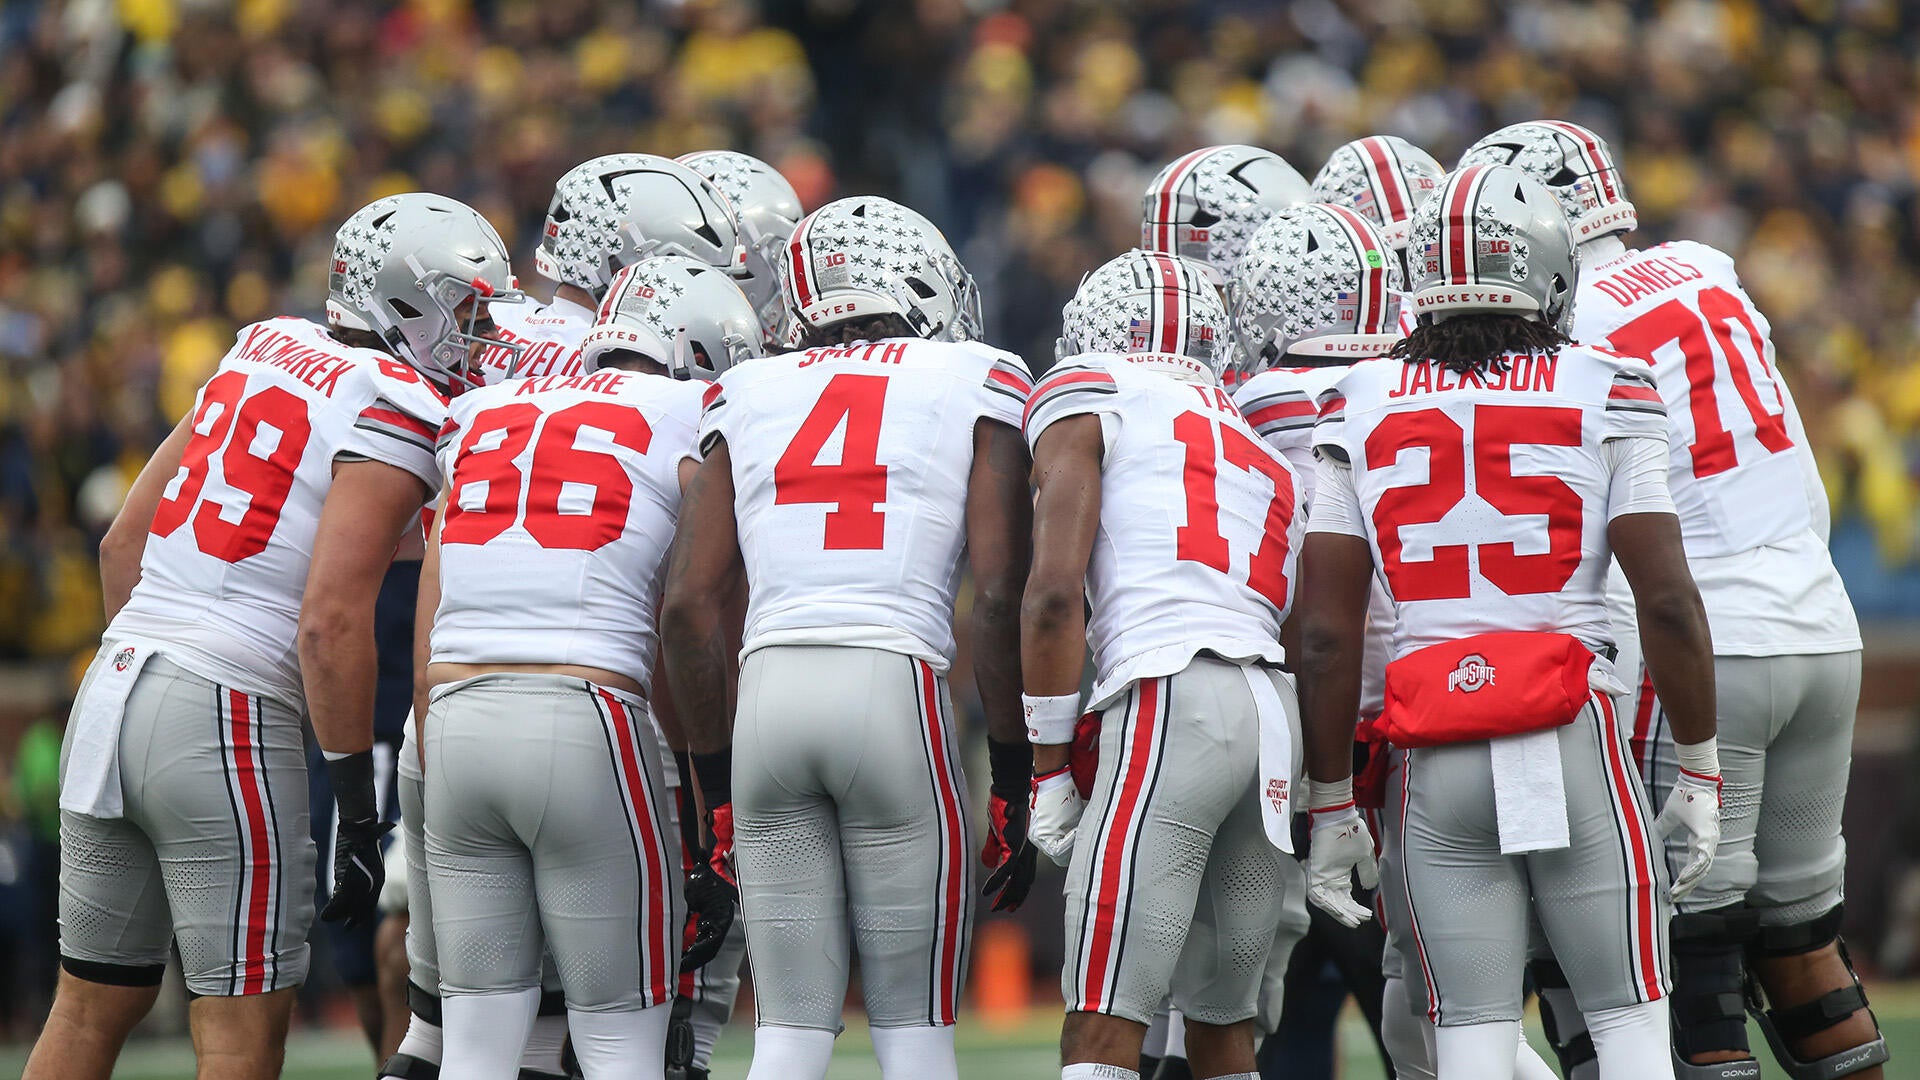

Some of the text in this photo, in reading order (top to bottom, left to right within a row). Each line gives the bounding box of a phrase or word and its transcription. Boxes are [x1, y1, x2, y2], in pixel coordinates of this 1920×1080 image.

[1426, 260, 1438, 272] 25
[1592, 256, 1704, 308] DANIELS
[1341, 310, 1354, 321] 10
[1417, 293, 1512, 307] BUCKEYES
[580, 331, 638, 353] CKEYES
[789, 303, 856, 344] BUCEYES
[1132, 336, 1145, 348] 17
[235, 324, 356, 399] KACMAREK
[798, 343, 908, 368] SMITH
[1325, 343, 1394, 352] BUCKEY
[515, 373, 633, 396] KLARE
[1389, 354, 1558, 398] JACKSON
[1605, 285, 1796, 480] 70
[1187, 384, 1248, 426] TA
[149, 370, 312, 564] 89
[441, 400, 653, 552] 86
[774, 374, 888, 550] 4
[1173, 410, 1296, 611] 17
[1364, 404, 1584, 602] 25
